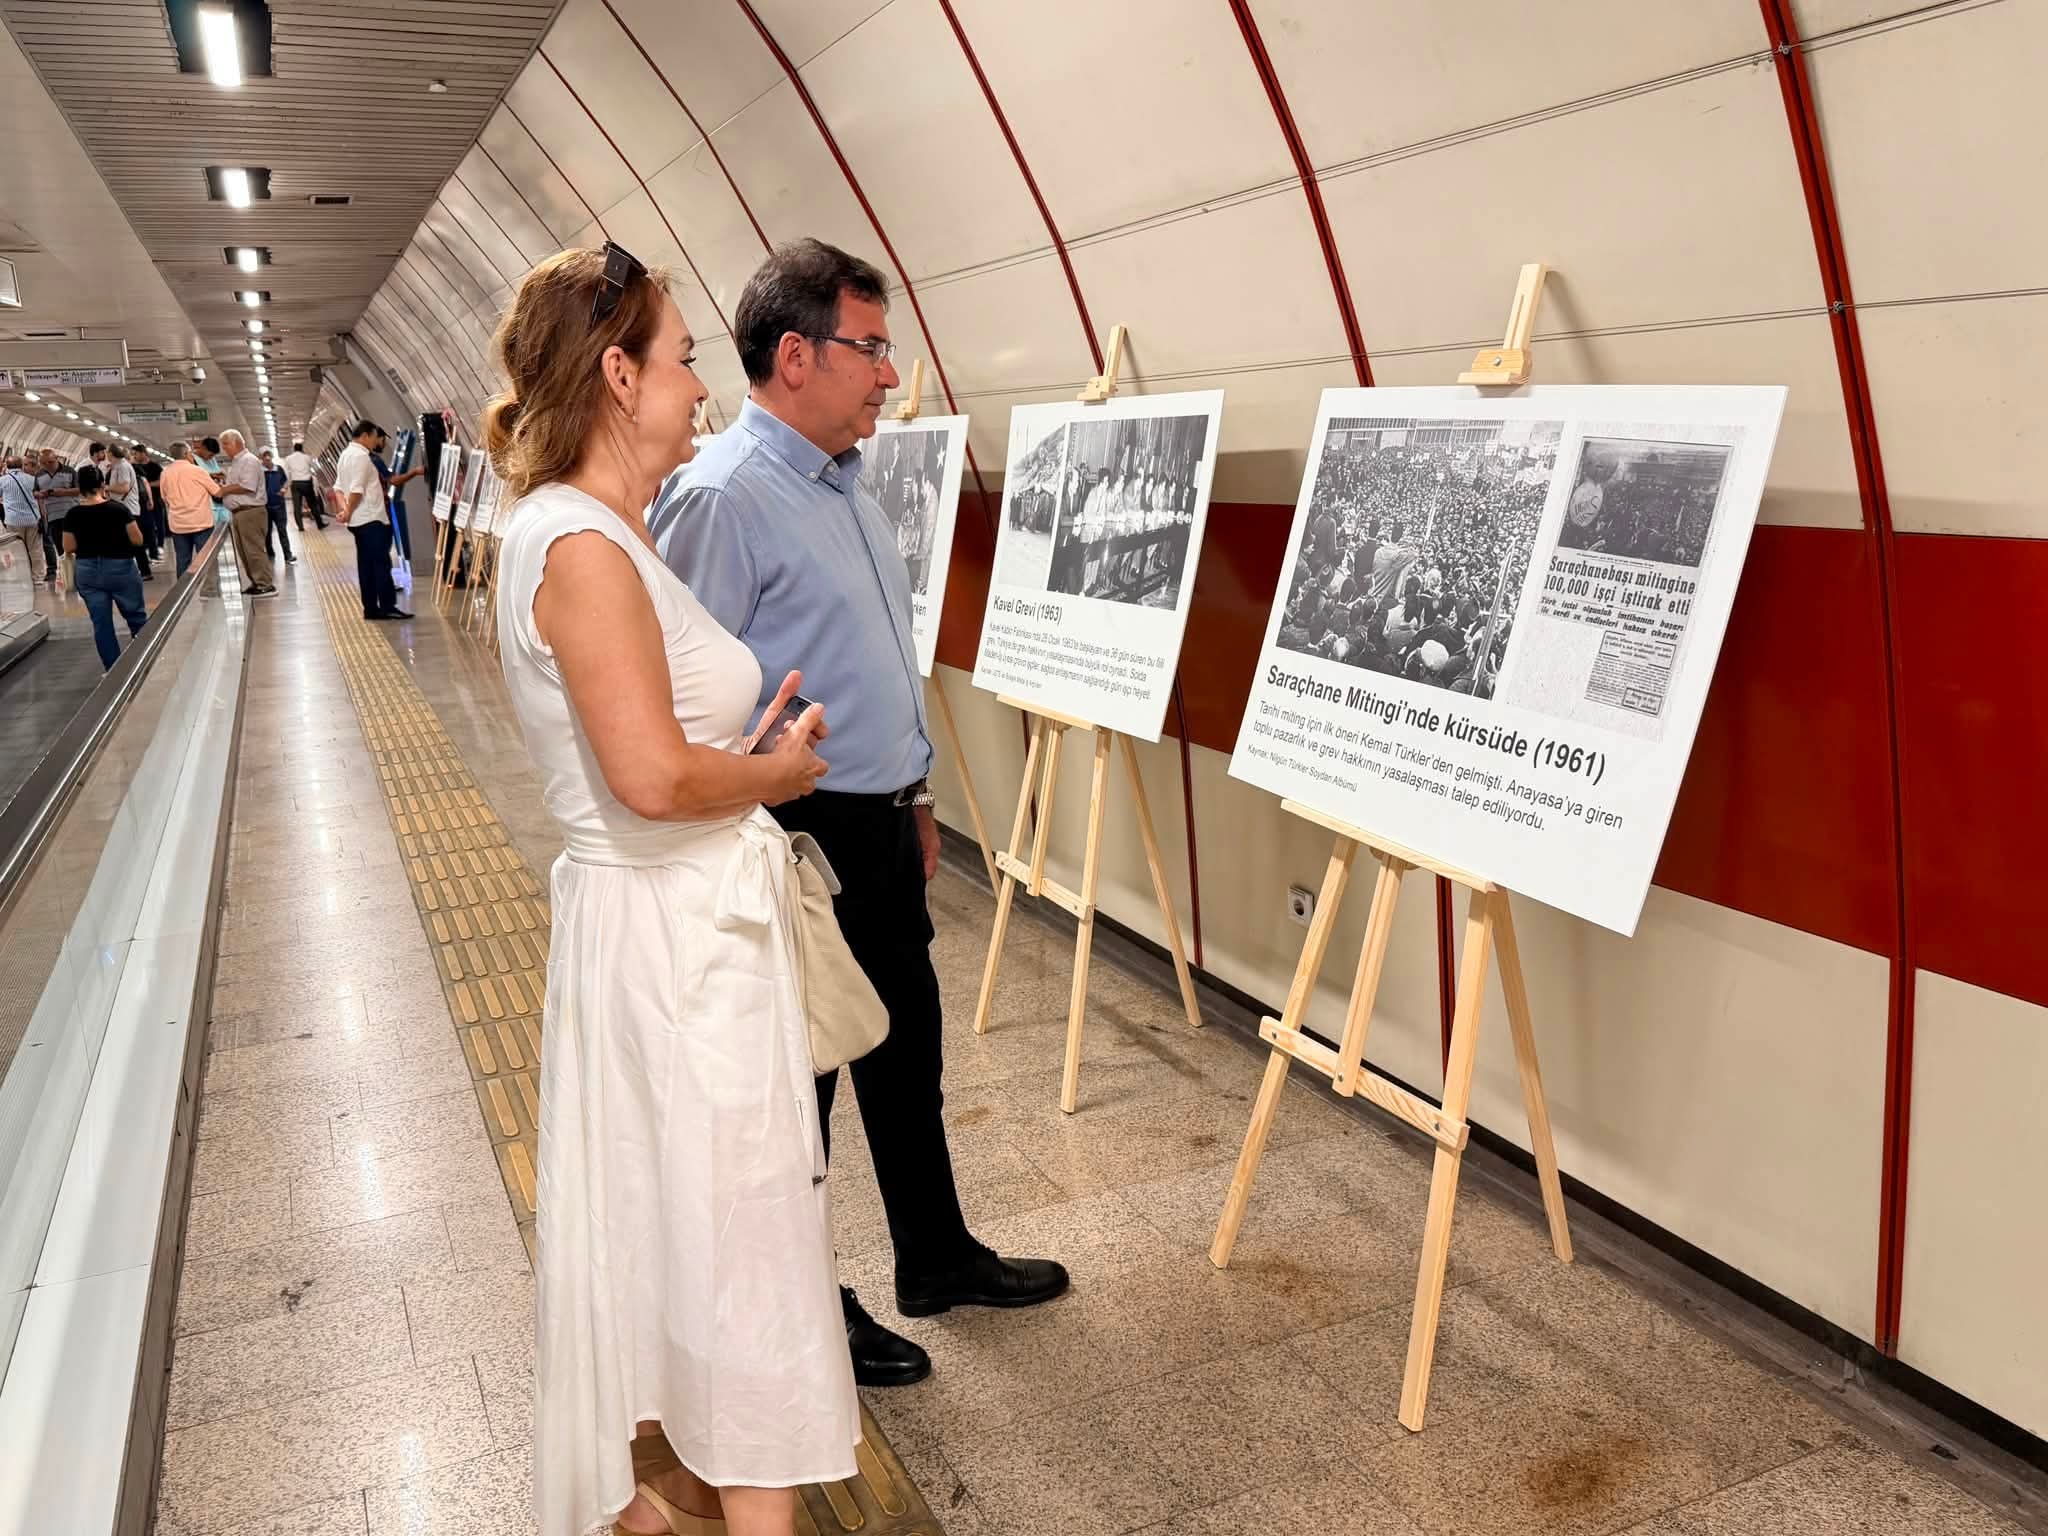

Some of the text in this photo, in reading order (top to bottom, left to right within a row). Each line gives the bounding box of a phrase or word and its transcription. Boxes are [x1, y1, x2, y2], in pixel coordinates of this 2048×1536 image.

[1544, 575, 1691, 615] 100,000 işçi iştirak etti
[1550, 556, 1633, 586] Saraçhanebaşı
[1635, 571, 1695, 594] mitingine
[994, 596, 1062, 625] Kavel Grevi (1963)
[1268, 665, 1605, 786] Saraçhane Mitingi'nde kürsüde (1961)
[1248, 744, 1268, 759] Kaynak:
[1309, 766, 1331, 782] Soydan
[1332, 775, 1358, 793] Albümü
[1254, 720, 1545, 831] toplu pazarlık ve grev hakkının yasalaşması talep ediliyordu.
[1259, 700, 1623, 829] Tarihi miting için ilk öneri Kemal Türkler'den gelmişti. Anayasa'ya giren
